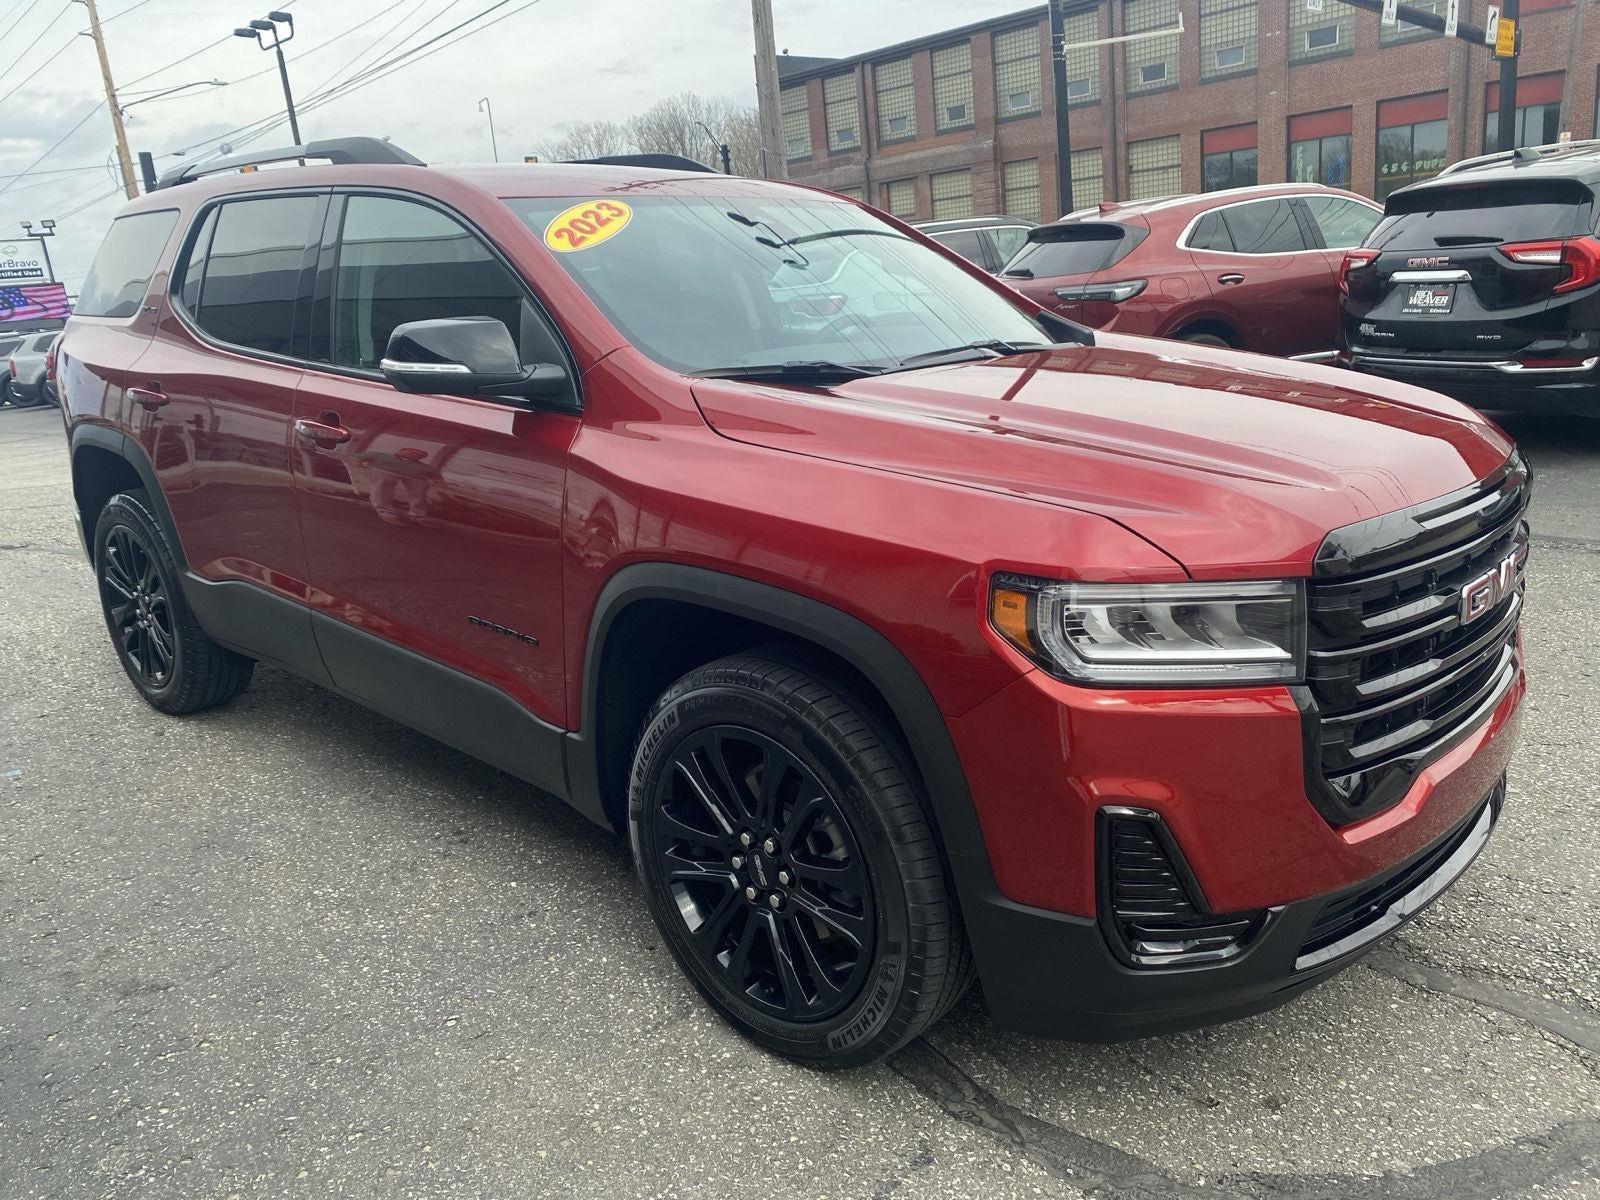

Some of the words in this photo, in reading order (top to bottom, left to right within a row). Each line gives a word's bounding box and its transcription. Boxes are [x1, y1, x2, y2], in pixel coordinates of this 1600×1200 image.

[554, 202, 626, 248] 2023
[1407, 256, 1450, 268] GMC
[1409, 295, 1449, 305] WEAVER
[1413, 290, 1434, 298] RICK
[634, 710, 677, 782] MICHELIN
[753, 854, 768, 886] GMC
[830, 983, 889, 1050] MICHELIN
